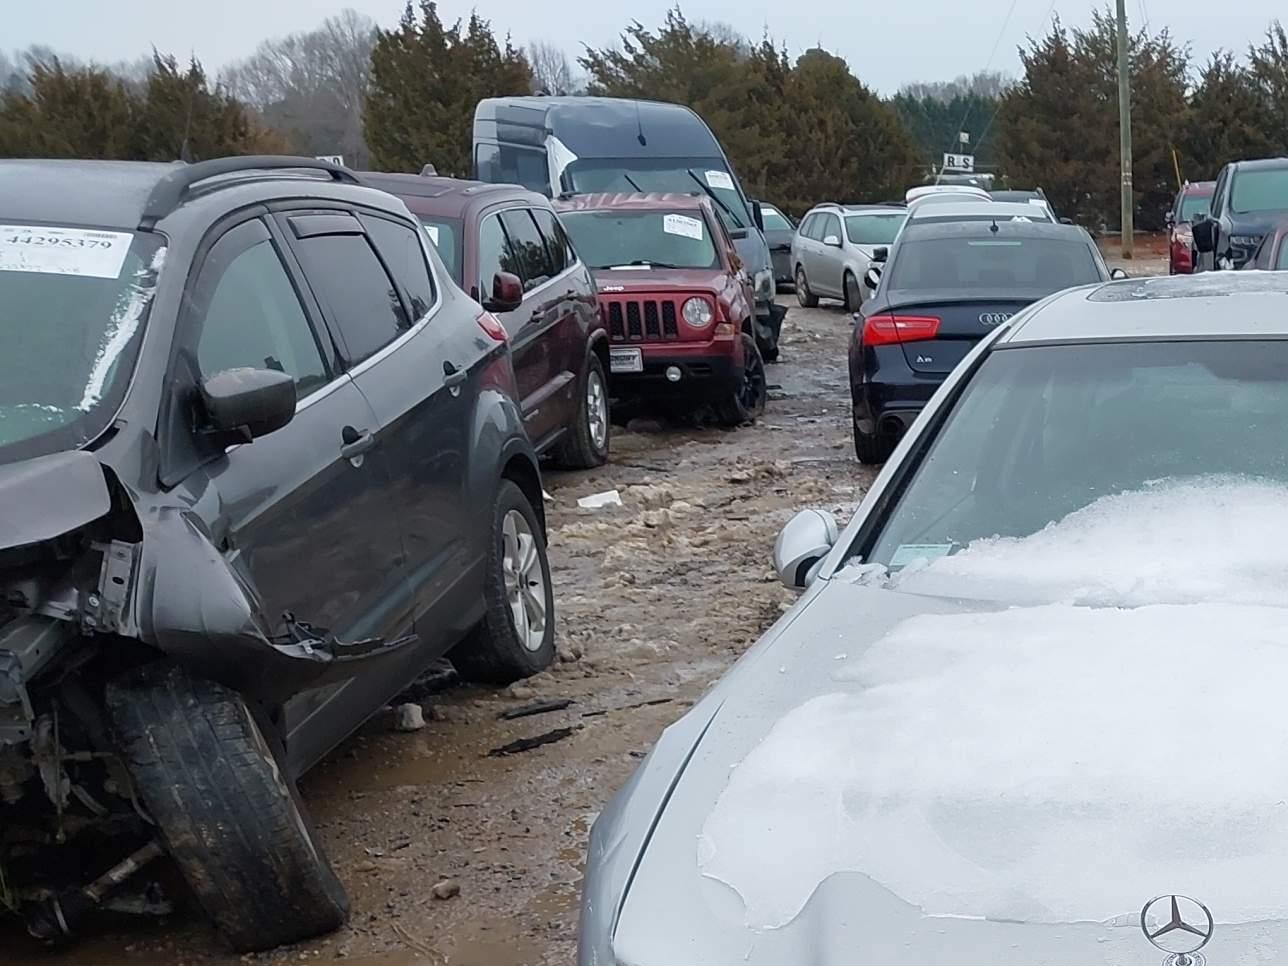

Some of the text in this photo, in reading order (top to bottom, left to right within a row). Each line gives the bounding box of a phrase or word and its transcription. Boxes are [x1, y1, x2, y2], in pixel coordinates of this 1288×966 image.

[947, 156, 970, 169] R S
[5, 235, 113, 249] 44295379
